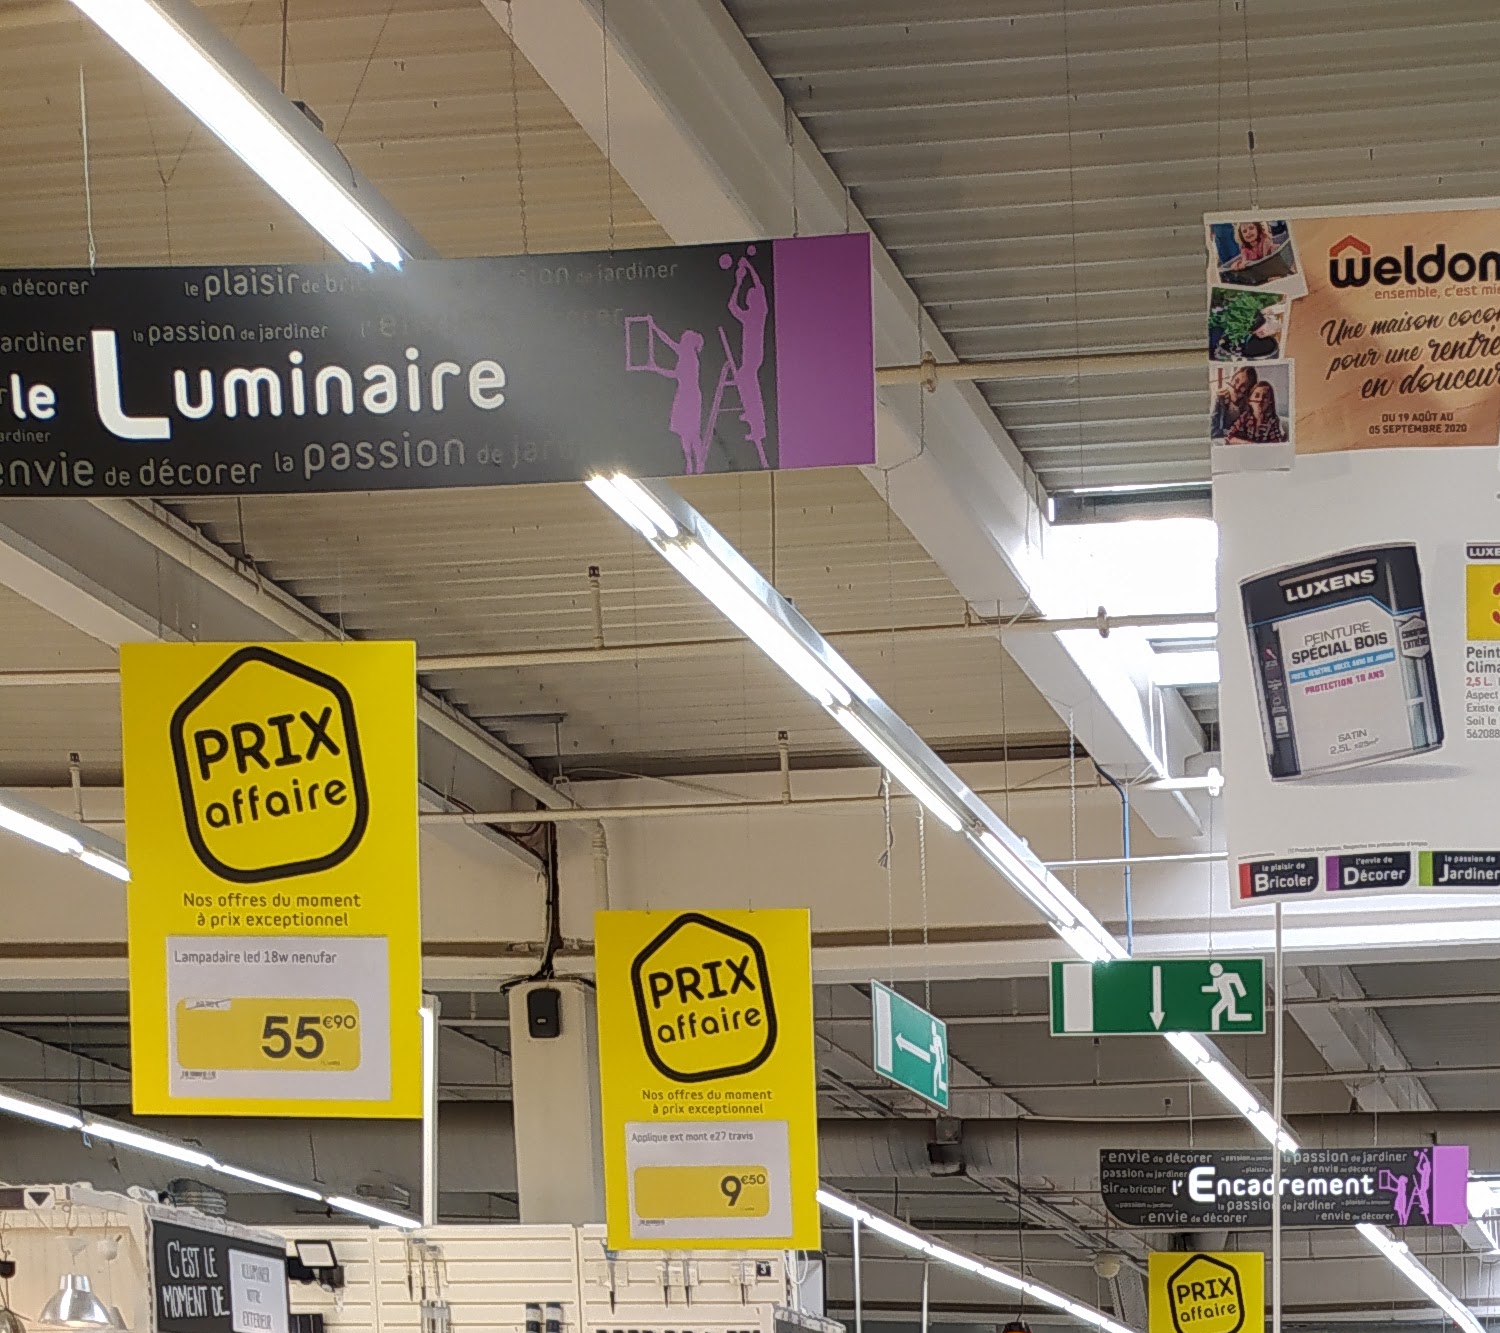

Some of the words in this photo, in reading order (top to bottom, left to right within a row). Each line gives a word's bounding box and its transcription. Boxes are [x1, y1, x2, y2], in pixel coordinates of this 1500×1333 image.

[12, 277, 89, 296] décorer
[184, 282, 199, 297] le
[204, 267, 299, 301] plaisir
[1375, 286, 1440, 299] ensemble,
[1444, 286, 1477, 297] c'est
[149, 320, 235, 346] passion
[258, 322, 329, 342] jardiner
[1320, 320, 1366, 346] Une
[1370, 311, 1444, 336] maison
[1326, 347, 1382, 380] pour
[1385, 345, 1425, 363] une
[11, 373, 56, 420] le
[91, 330, 506, 439] Luminaire
[1362, 376, 1394, 398] en
[1382, 413, 1396, 422] DU
[1399, 413, 1409, 421] 19
[1412, 411, 1437, 422] AOÛT
[1441, 413, 1454, 421] AU
[1383, 423, 1442, 434] SEPTEMBRE
[1445, 423, 1467, 433] 2020
[105, 466, 131, 486] de
[140, 458, 262, 485] décorer
[274, 451, 294, 473] la
[304, 431, 465, 480] passion
[1286, 569, 1375, 601] LUXENS
[1304, 622, 1371, 647] PEINTURE
[1291, 640, 1352, 665] SPÉCIAL
[1354, 631, 1388, 651] BOIS
[1466, 689, 1498, 701] Aspect
[1466, 703, 1495, 713] Existe
[1466, 716, 1485, 726] Soit
[1488, 716, 1498, 726] le
[194, 706, 341, 781] PRIX
[205, 778, 348, 829] affaire
[1254, 872, 1315, 892] Bricoler
[1343, 866, 1406, 886] Décorer
[1438, 863, 1500, 883] Jardiner
[174, 949, 241, 965] Lampadaire
[243, 949, 261, 964] led
[264, 950, 288, 964] 18w
[291, 950, 337, 964] nenufar
[648, 955, 756, 1010] PRIX
[657, 1006, 762, 1044] affaire
[632, 1131, 668, 1145] Applique
[670, 1131, 684, 1142] ext
[686, 1131, 708, 1142] mont
[728, 1130, 753, 1142] travis
[1165, 1152, 1212, 1163] décorer
[1294, 1150, 1348, 1165] passion
[1363, 1151, 1408, 1163] jardiner
[1102, 1168, 1144, 1179] passion
[167, 1240, 200, 1279] C'EST
[203, 1247, 218, 1278] LE
[162, 1285, 208, 1318] MOMENT
[1177, 1275, 1235, 1305] PRIX
[1180, 1301, 1237, 1324] affaire
